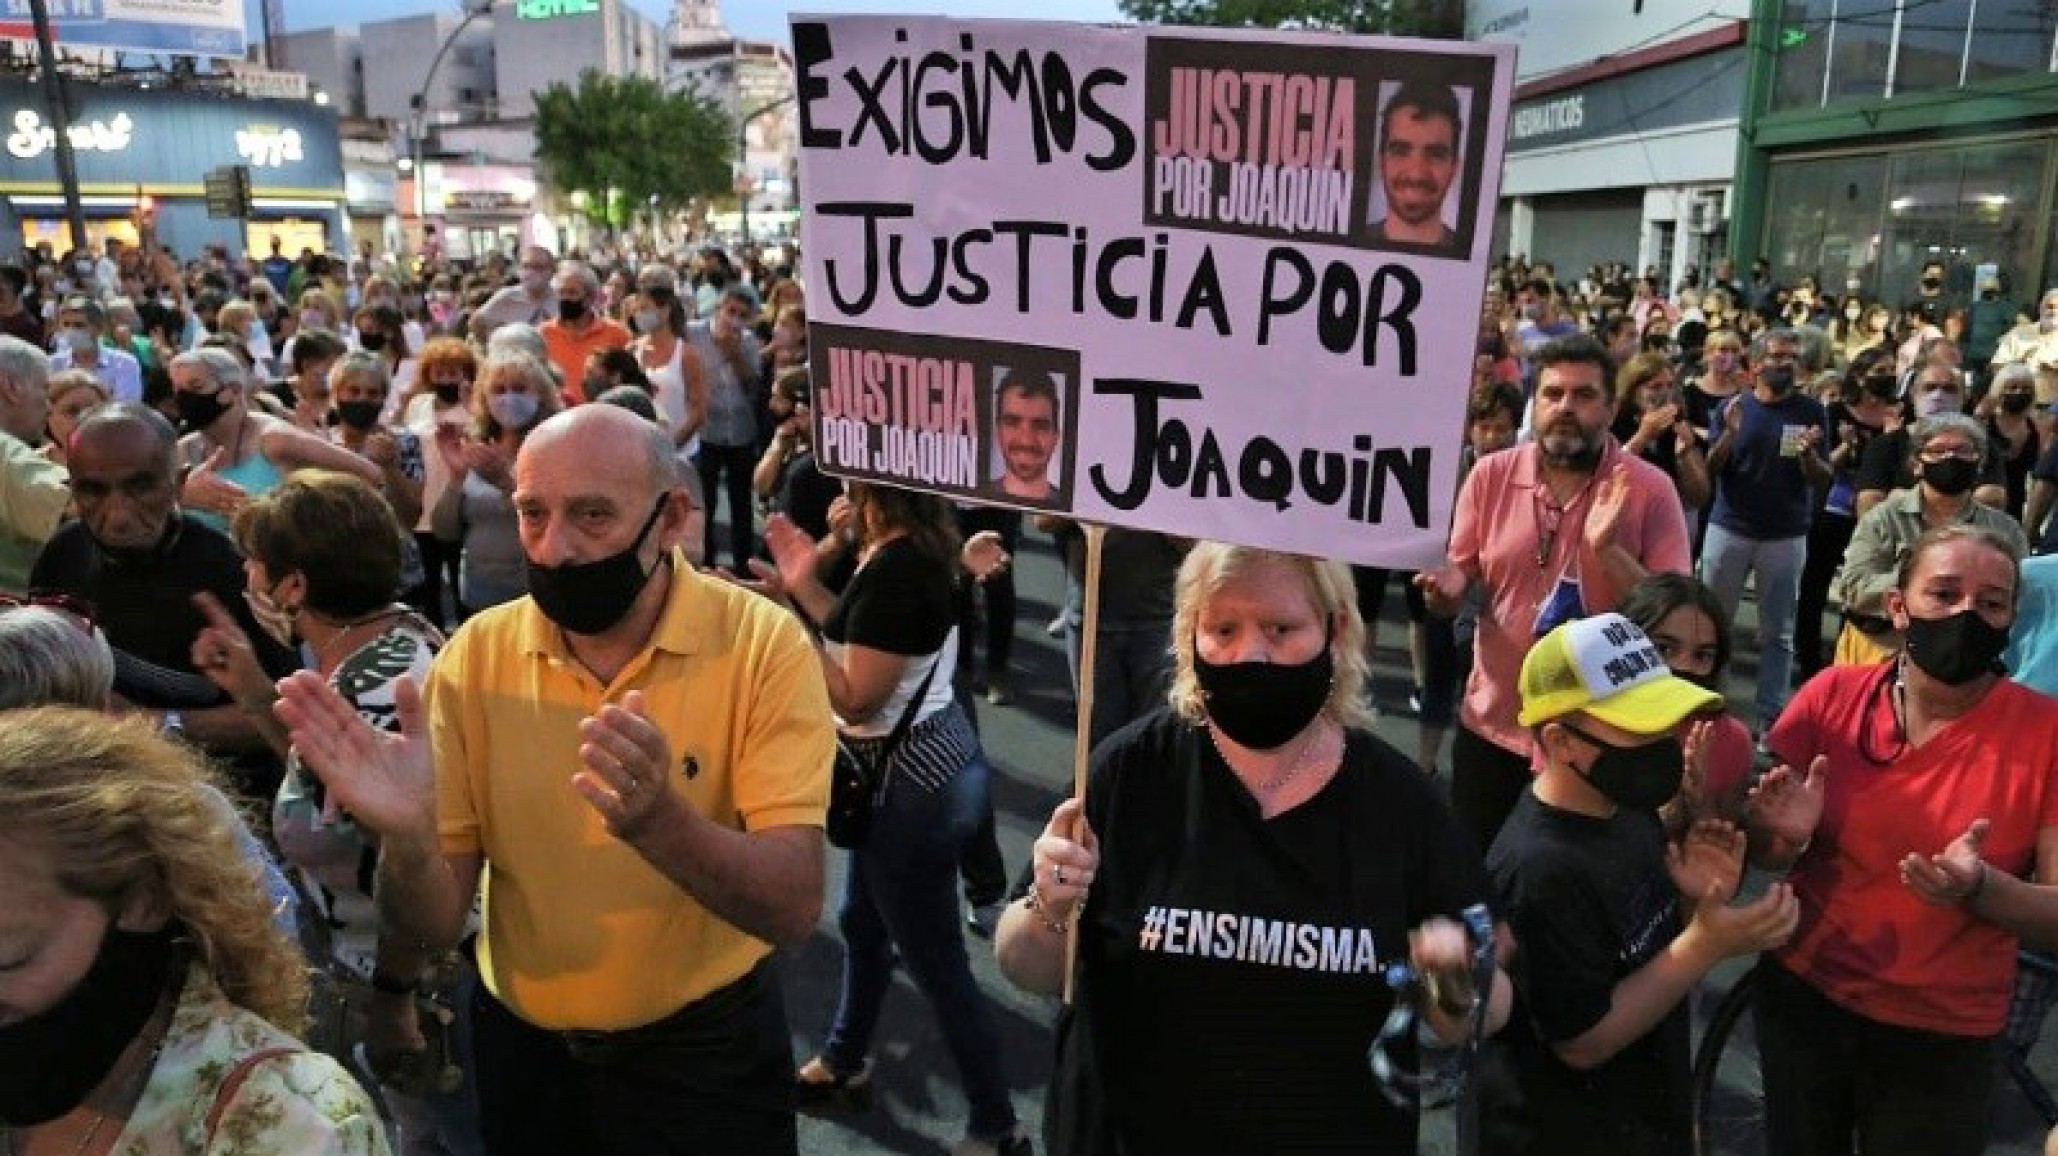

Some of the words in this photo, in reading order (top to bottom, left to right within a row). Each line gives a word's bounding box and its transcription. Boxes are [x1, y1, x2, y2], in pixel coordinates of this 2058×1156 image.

[1154, 67, 1355, 169] JUSTICIA
[1153, 156, 1210, 217] POR
[1257, 247, 1423, 376] POR
[820, 346, 976, 440] JUSTICIA
[822, 417, 869, 468] POR
[1139, 905, 1386, 974] #ENSIMISMA.
